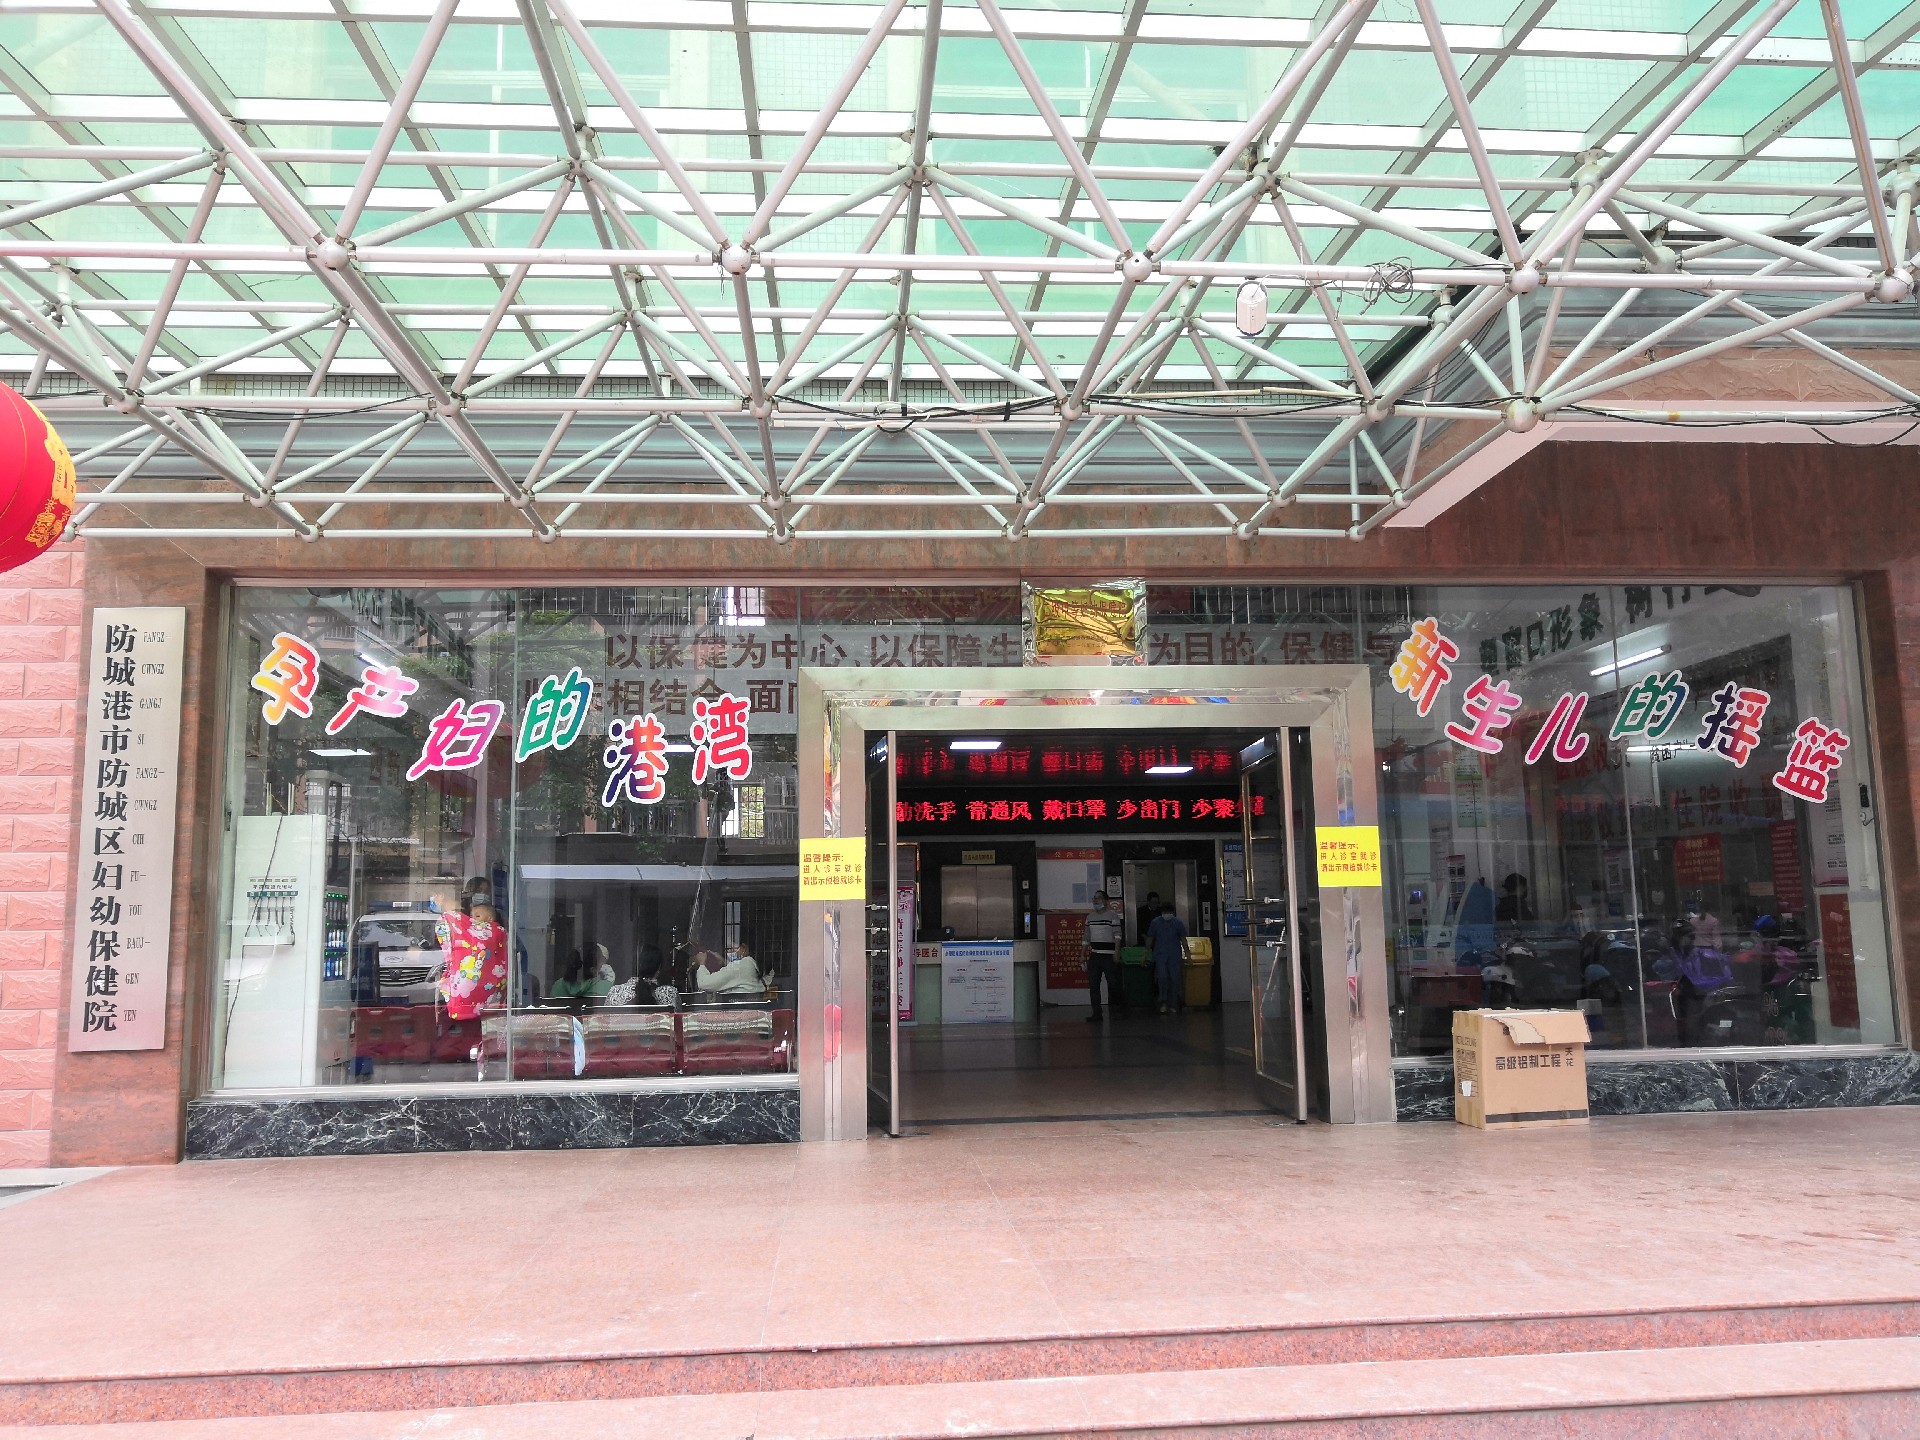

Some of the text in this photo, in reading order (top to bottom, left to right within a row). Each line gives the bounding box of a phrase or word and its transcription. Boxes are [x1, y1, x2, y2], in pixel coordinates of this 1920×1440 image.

[251, 631, 753, 808] 孕产妇的港湾
[1388, 615, 1851, 805] 新生儿的摇篮
[82, 624, 138, 1033] 防城港市防城区妇幼保健院
[965, 800, 1033, 822] 常通风
[1042, 798, 1107, 822] 戴口罩
[1115, 798, 1181, 822] 少出门
[1495, 1053, 1562, 1071] 高级铝制工程
